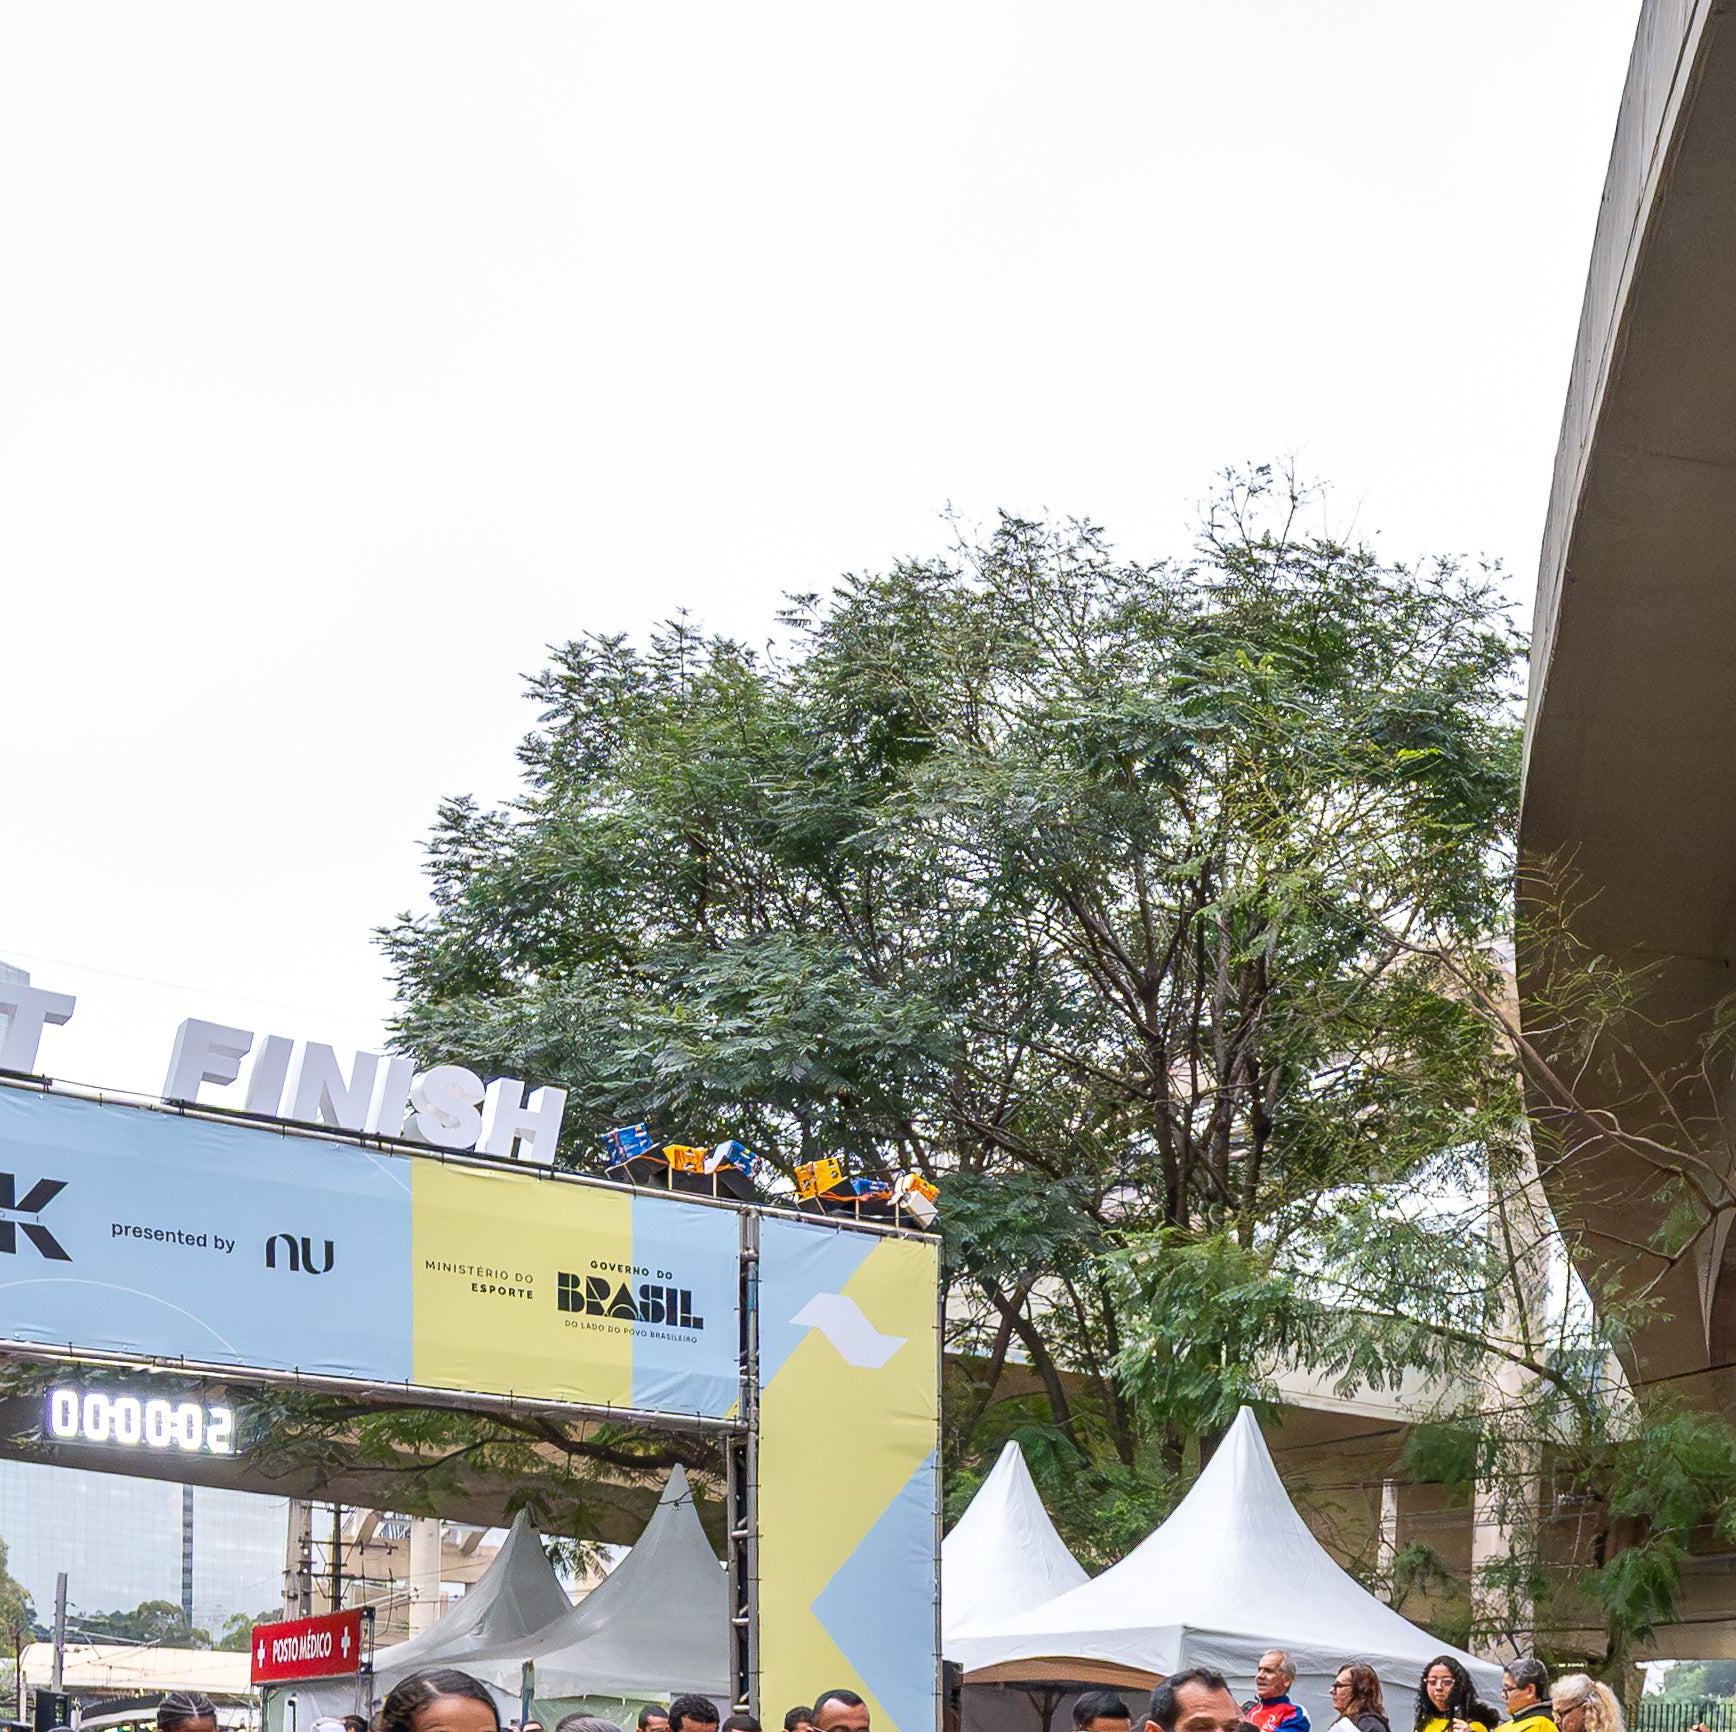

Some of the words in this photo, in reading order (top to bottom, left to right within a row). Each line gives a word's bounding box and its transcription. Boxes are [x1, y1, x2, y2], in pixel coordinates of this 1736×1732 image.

[163, 1017, 570, 1167] FINISH
[111, 1222, 207, 1249] presented
[213, 1234, 236, 1254] by
[424, 1259, 509, 1281] MINISTÉRIO
[515, 1273, 534, 1284] DO
[590, 1259, 650, 1277] GOVERNO
[656, 1269, 673, 1280] DO
[471, 1282, 534, 1300] ESPORTE
[557, 1271, 704, 1330] BRASIL
[564, 1319, 578, 1328] DO
[581, 1321, 605, 1332] LADO
[608, 1325, 621, 1335] DO
[623, 1327, 648, 1338] POVO
[650, 1331, 698, 1344] BRASILEIRO
[272, 1635, 299, 1664] POSTO
[299, 1628, 332, 1661] MÉDICO
